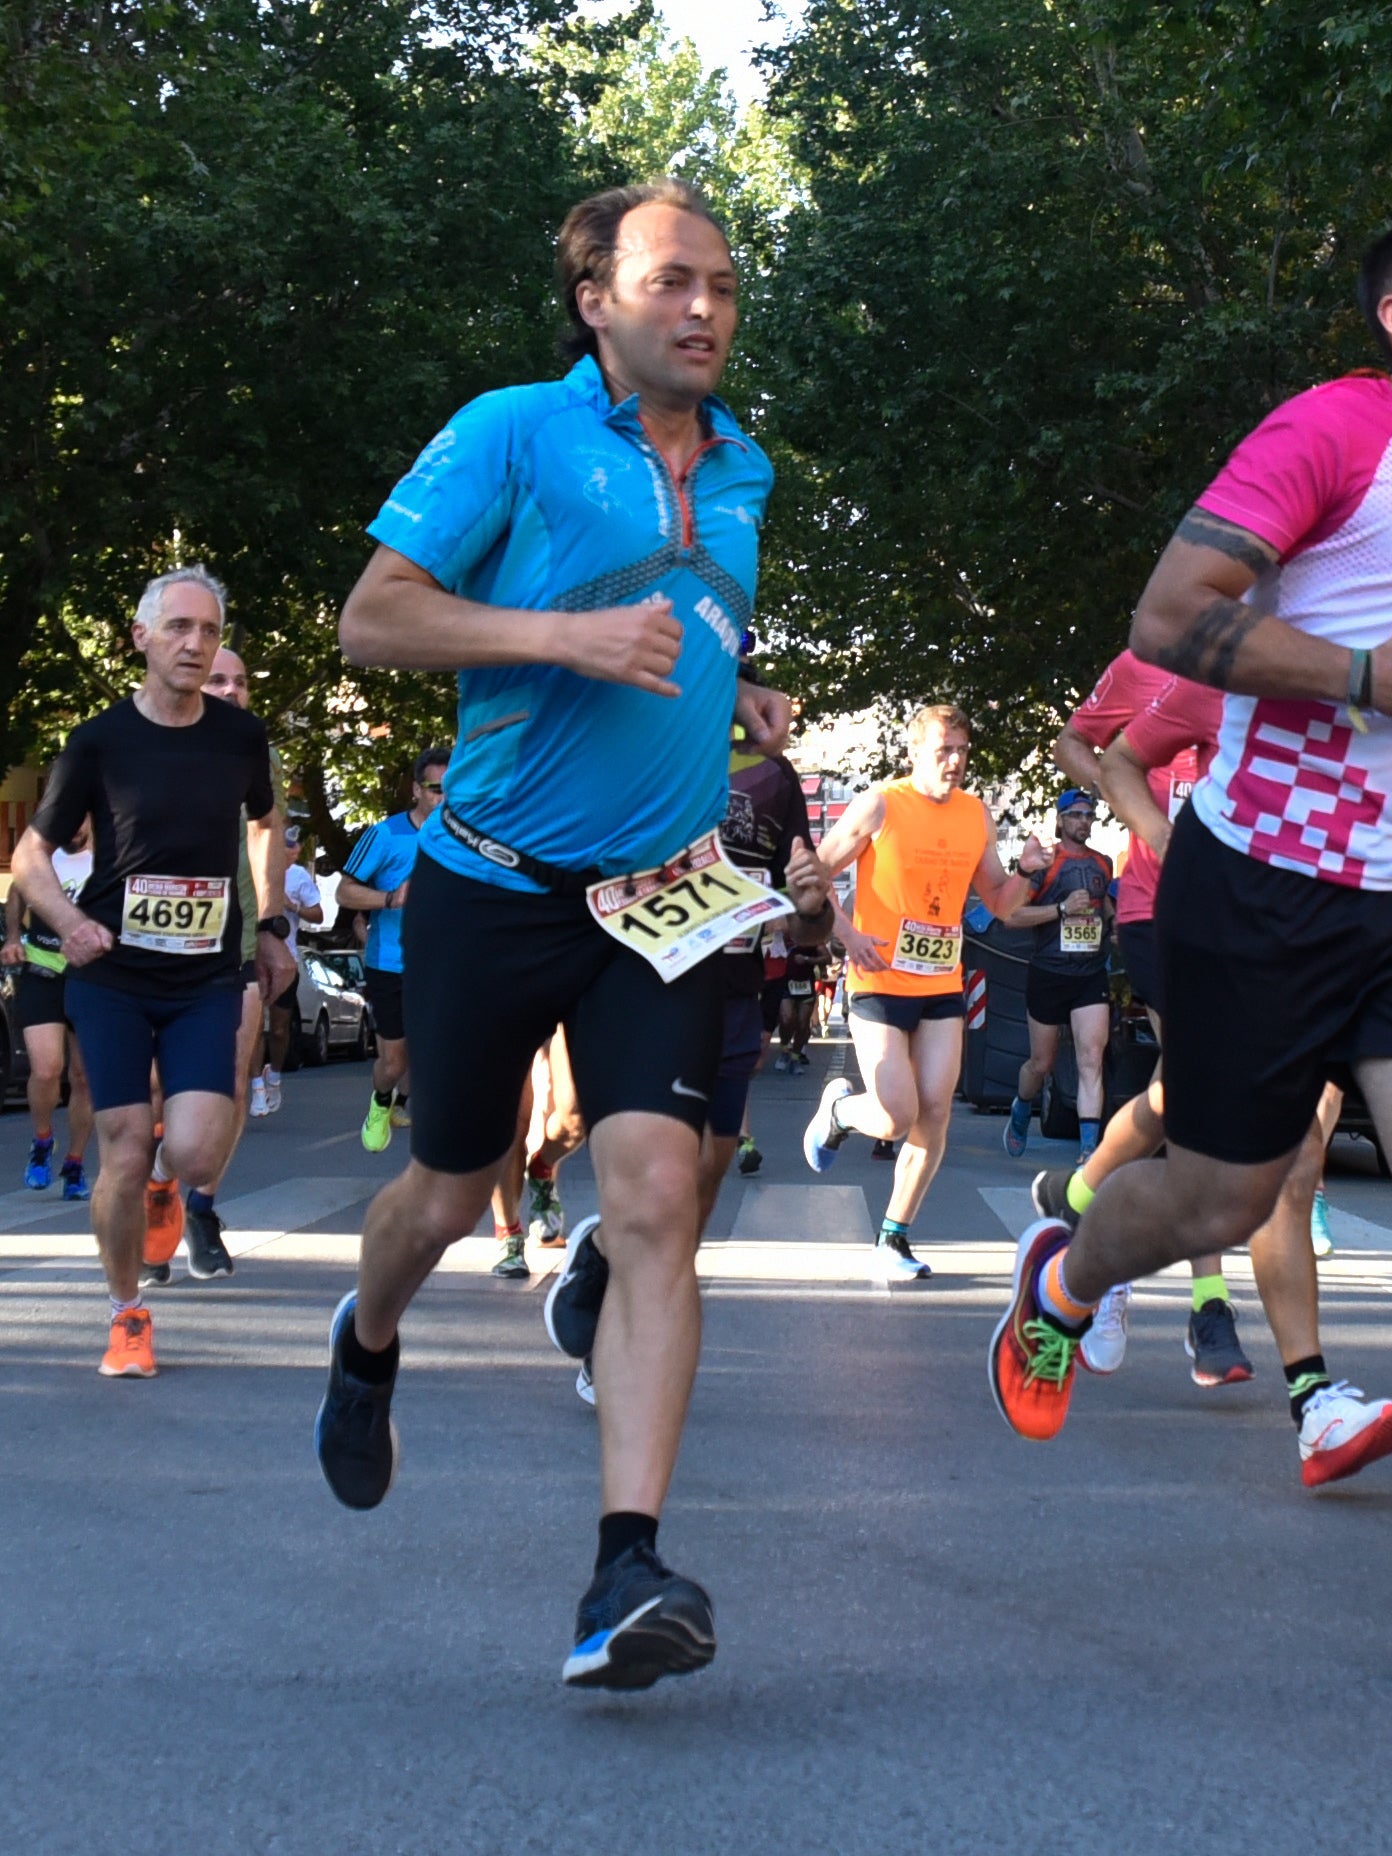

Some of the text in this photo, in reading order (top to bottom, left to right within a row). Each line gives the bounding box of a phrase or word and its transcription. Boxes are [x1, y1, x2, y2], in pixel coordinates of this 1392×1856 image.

[131, 879, 148, 894] 40
[128, 898, 213, 930] 4697
[621, 871, 741, 939] 1571
[900, 933, 954, 960] 3623
[1064, 926, 1097, 940] 3565
